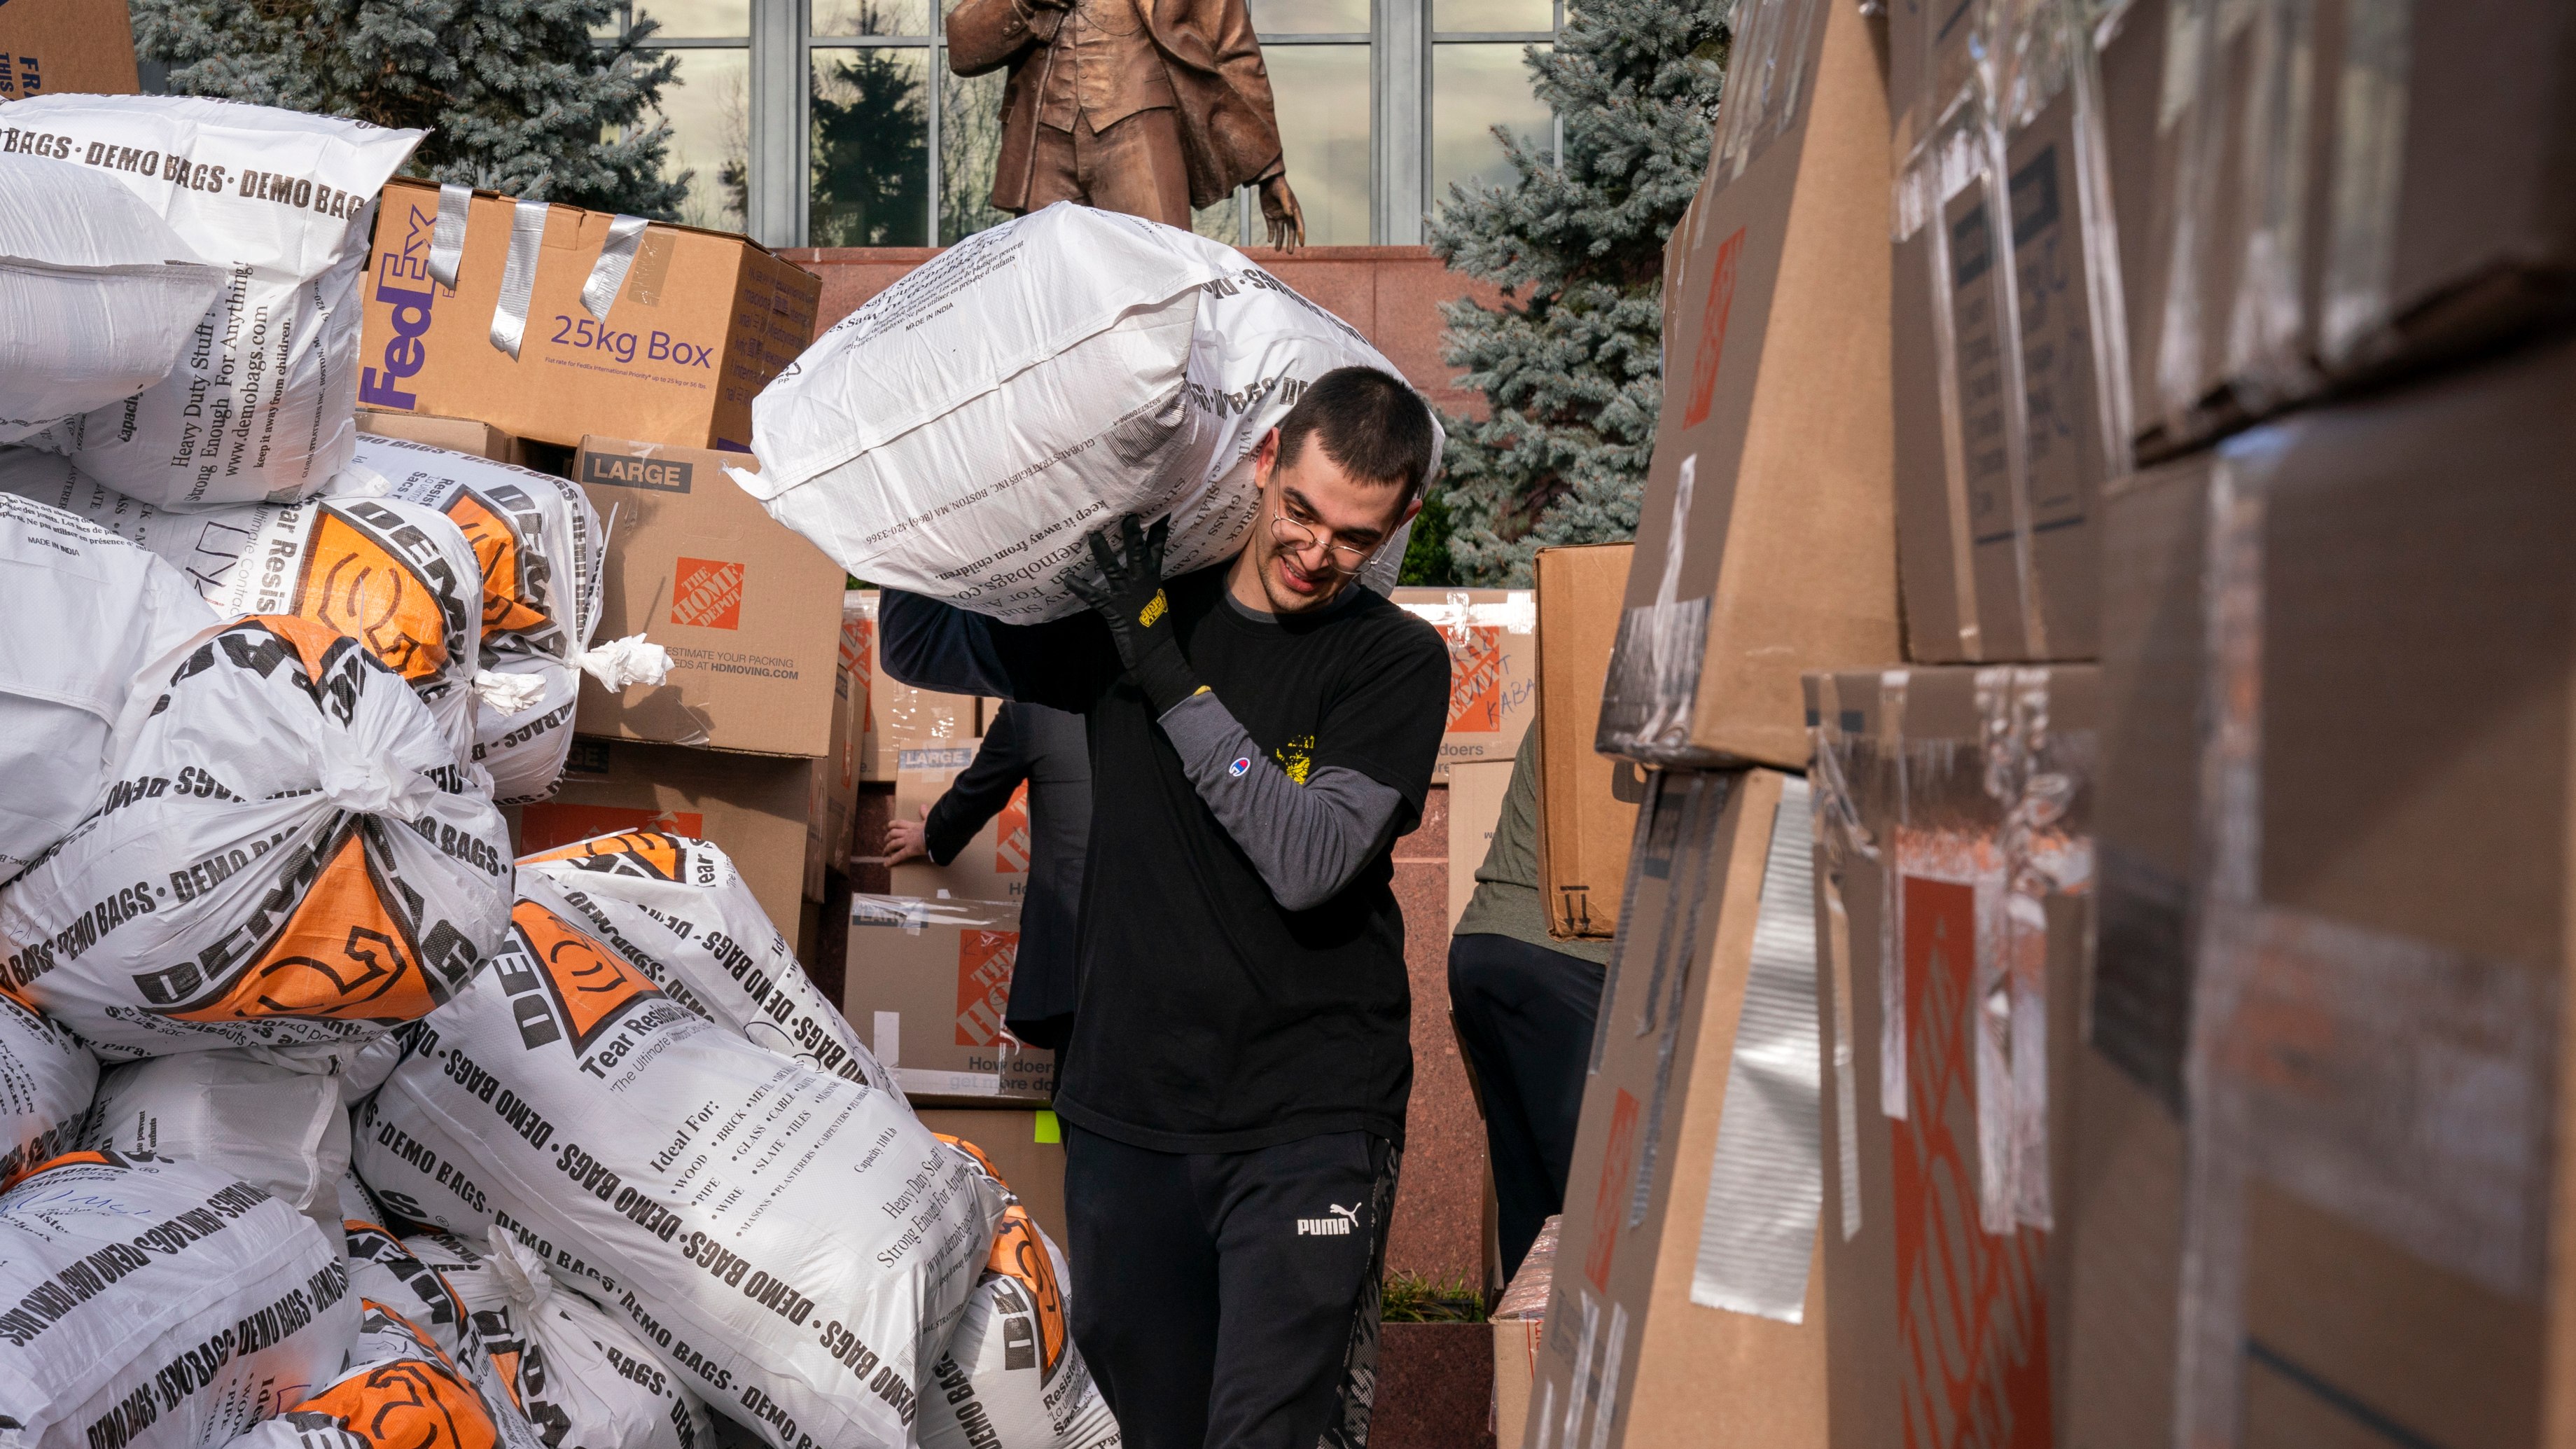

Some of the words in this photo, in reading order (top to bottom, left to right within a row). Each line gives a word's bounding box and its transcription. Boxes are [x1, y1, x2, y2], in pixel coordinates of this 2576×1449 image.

[4, 127, 72, 159] BAGS
[85, 141, 160, 176] DEMO
[162, 153, 225, 193] BAGS
[239, 169, 312, 209] DEMO
[927, 292, 950, 307] utiliser
[950, 286, 959, 295] en
[993, 254, 1016, 271] enfants
[220, 260, 253, 351] Anything!
[905, 317, 924, 332] MADE
[926, 313, 934, 322] IN
[935, 302, 954, 319] INDIA
[190, 321, 215, 370] Stuff
[276, 317, 292, 377] children.
[550, 315, 637, 363] 25kg
[648, 331, 713, 368] Box
[215, 354, 236, 388] For
[594, 365, 628, 375] International
[183, 373, 211, 419] Duty
[225, 305, 269, 477] www.demobags.com
[270, 377, 284, 405] from
[200, 397, 232, 459] Enough
[265, 406, 279, 433] away
[171, 421, 202, 468] Heavy
[253, 444, 271, 469] keep
[264, 433, 271, 445] it
[388, 440, 447, 455] BAGS
[1063, 438, 1096, 458] GLOBAL
[184, 464, 218, 502] Strong
[594, 457, 681, 487] LARGE
[934, 505, 950, 518] MA
[952, 488, 989, 510] BOSTON,
[1075, 499, 1111, 521] keep
[1207, 494, 1242, 536] GLASS
[27, 517, 39, 526] Ne
[90, 536, 125, 546] présence
[865, 522, 909, 546] 420-3366
[908, 511, 934, 527] (866)
[1028, 522, 1063, 548] away
[1062, 517, 1076, 530] it
[1225, 498, 1261, 543] BRICK
[27, 536, 50, 547] MADE
[51, 541, 60, 550] IN
[60, 545, 81, 557] INDIA
[996, 538, 1029, 560] from
[681, 566, 712, 593] THE
[934, 557, 993, 581] children.
[671, 561, 744, 625] HOME
[697, 587, 741, 628] DEPOT
[1009, 585, 1045, 602] For
[1141, 596, 1163, 623] GRIP
[666, 646, 715, 660] ESTIMATE
[717, 651, 746, 664] YOUR
[749, 655, 794, 669] PACKING
[697, 662, 709, 672] AT
[711, 663, 799, 680] HDMOVING.COM
[905, 751, 965, 766] LARGE
[1439, 743, 1484, 756] doers
[103, 776, 172, 817] DEMO
[440, 822, 499, 878] BAGS
[95, 881, 157, 938] BAGS
[169, 850, 249, 903] DEMO
[702, 931, 754, 983] BAGS
[742, 974, 795, 1025] DEMO
[794, 1015, 847, 1072] BAGS
[579, 1032, 635, 1080] Tear
[632, 1034, 671, 1072] Ultimate
[968, 1056, 1008, 1072] How
[649, 1128, 693, 1174] Ideal
[684, 1100, 720, 1134] For:
[674, 1153, 709, 1189] WOOD
[716, 1109, 748, 1143] BRICK
[696, 1177, 721, 1202] PIPE
[737, 1123, 767, 1157] GLASS
[768, 1091, 796, 1120] CABLE
[854, 1144, 885, 1174] Capacity
[876, 1133, 892, 1149] 110
[887, 1126, 898, 1139] Lb
[716, 1186, 746, 1214] WIRE
[756, 1137, 786, 1171] SLATE
[788, 1109, 812, 1134] TILES
[739, 1198, 773, 1234] MASONS
[774, 1149, 818, 1195] PLASTERERS
[817, 1109, 851, 1147] CARPENTERS
[882, 1188, 920, 1220] Heavy
[906, 1170, 932, 1196] Duty
[443, 1048, 501, 1105] BAGS
[494, 1088, 555, 1151] DEMO
[555, 1143, 622, 1202] BAGS
[613, 1186, 683, 1244] DEMO
[682, 1230, 751, 1289] BAGS
[743, 1270, 816, 1326] DEMO
[819, 1319, 881, 1382] BAGS
[870, 1366, 917, 1427] DEMO
[877, 1228, 923, 1269] Strong
[912, 1198, 942, 1235] Enough
[935, 1188, 951, 1212] For
[1298, 1217, 1350, 1235] PUMA
[377, 1119, 436, 1175] DEMO
[434, 1160, 488, 1214] BAGS
[555, 1248, 618, 1293] BAGS
[619, 1289, 674, 1349] DEMO
[671, 1339, 733, 1392] BAGS
[739, 1385, 797, 1442] DEMO
[86, 1405, 127, 1449] DEMO
[125, 1382, 157, 1441] BAGS
[187, 1329, 234, 1388] BAGS
[237, 1308, 280, 1357] DEMO
[279, 1288, 312, 1338] BAGS
[307, 1264, 344, 1315] DEMO
[606, 1340, 667, 1399] BAGS
